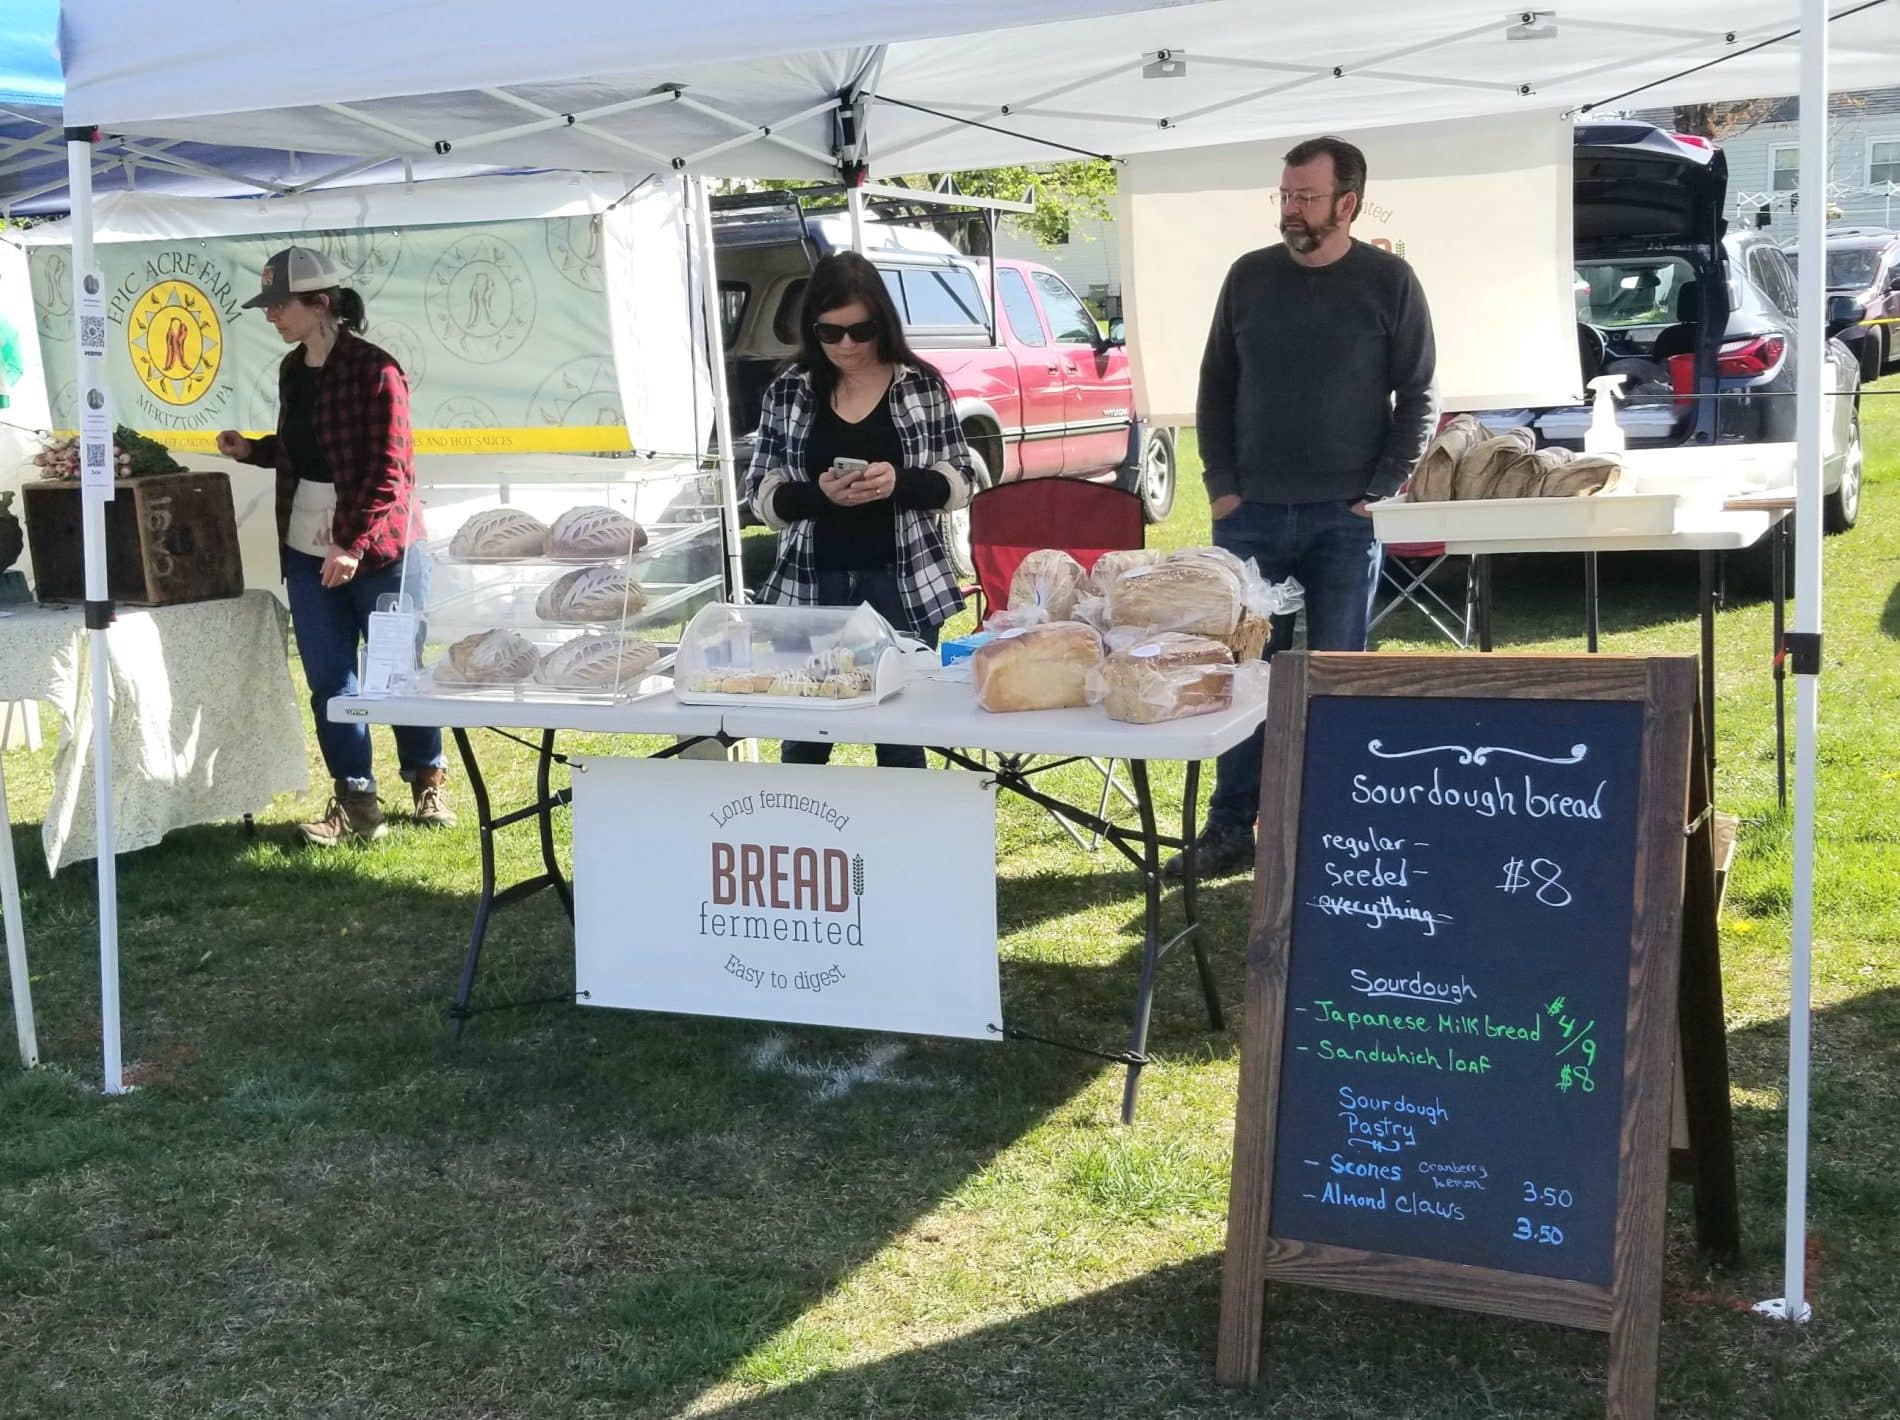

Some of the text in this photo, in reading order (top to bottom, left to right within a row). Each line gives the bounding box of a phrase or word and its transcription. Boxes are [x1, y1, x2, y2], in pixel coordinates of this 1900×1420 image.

[107, 252, 243, 325] EPIC ACRE FARM
[216, 384, 234, 405] PA
[710, 790, 849, 832] Long fermented
[1352, 768, 1607, 819] Sourdough bread
[712, 842, 849, 912] BREAD
[1495, 856, 1572, 907] $8
[699, 896, 864, 947] fermented
[723, 953, 846, 992] Easy to digest
[1351, 968, 1477, 1003] Sourdough
[1314, 1000, 1431, 1032] Japanese
[1485, 1013, 1540, 1041] bread
[1317, 1039, 1442, 1070] Sandwhich
[1555, 1063, 1595, 1093] $8
[1339, 1086, 1448, 1125] Sourdough
[1338, 1111, 1416, 1145] Pastry
[1330, 1153, 1402, 1181] Scones
[1523, 1181, 1573, 1208] 3.50
[1512, 1217, 1564, 1245] 3.50
